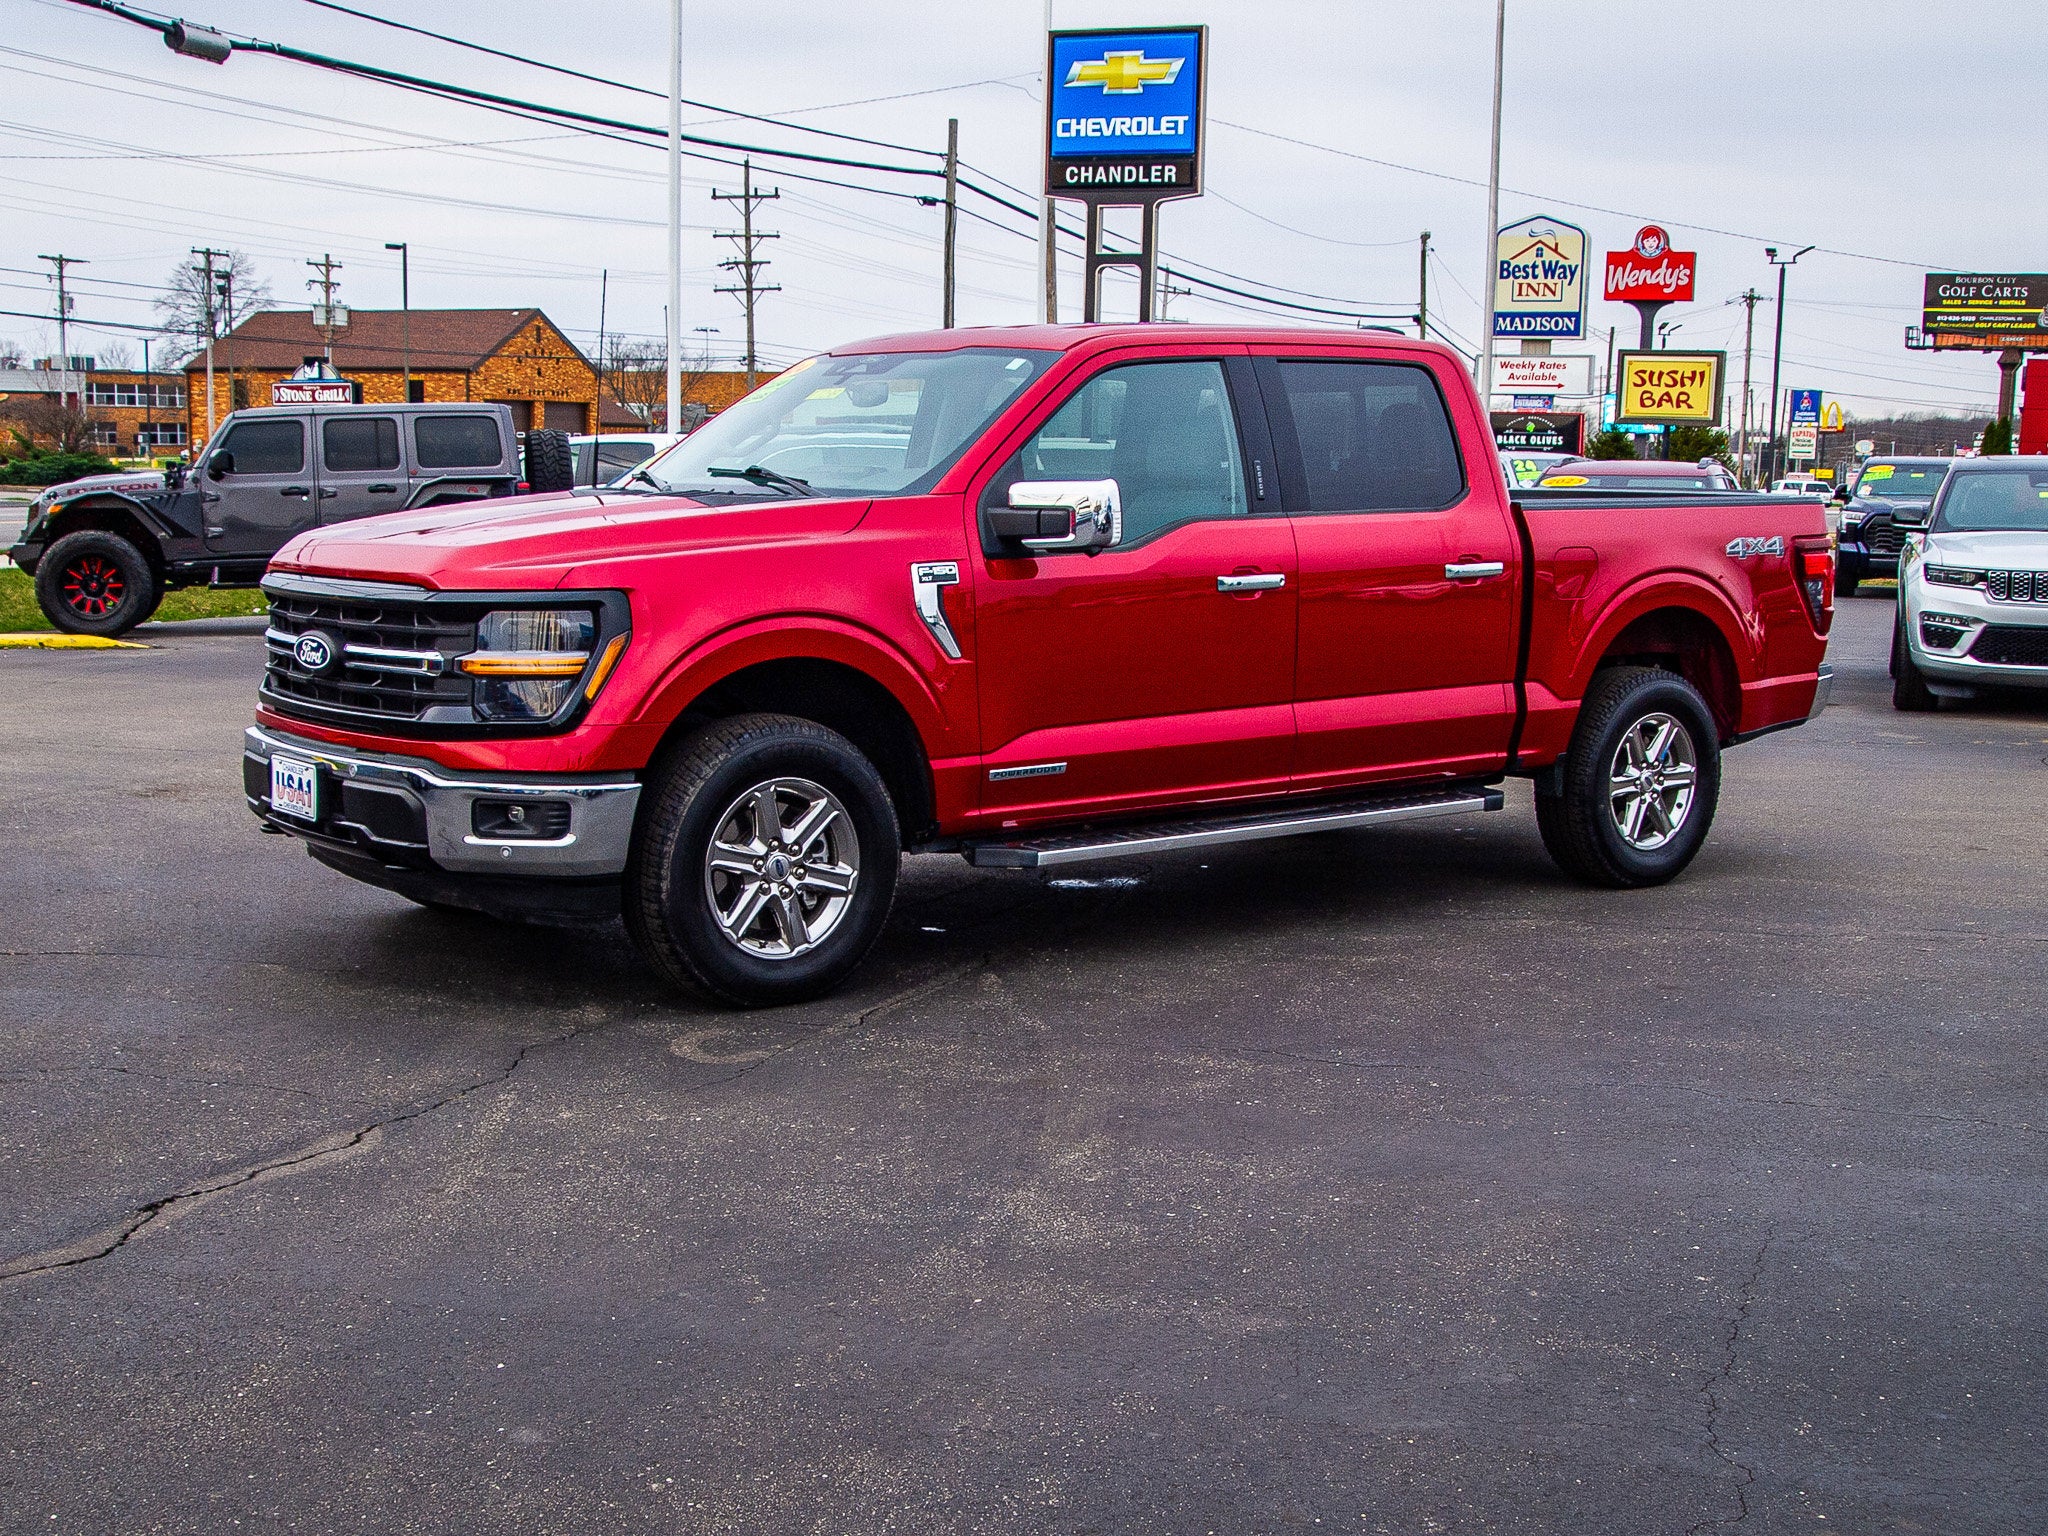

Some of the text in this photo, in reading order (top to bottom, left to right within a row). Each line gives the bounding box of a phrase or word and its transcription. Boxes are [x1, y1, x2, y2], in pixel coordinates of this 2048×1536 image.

[1057, 116, 1189, 137] CHEVROLET
[1065, 165, 1177, 183] CHANDLER
[1500, 259, 1579, 286] Best Way
[1608, 258, 1690, 293] Wendy's
[1997, 276, 2017, 284] CITY
[1516, 283, 1558, 297] INN
[1939, 285, 2029, 297] GOLF CARTS
[1496, 317, 1576, 331] MADISON
[1499, 361, 1567, 371] Weekly Rates
[1507, 372, 1557, 381] Available
[1632, 370, 1706, 388] SUSHI
[280, 387, 346, 401] STONE GRILL
[1640, 390, 1694, 409] BAR
[1496, 435, 1563, 445] BLACK OLIVES
[300, 640, 324, 664] Ford
[991, 764, 1065, 779] POWERBOOST
[276, 771, 311, 808] USA1
